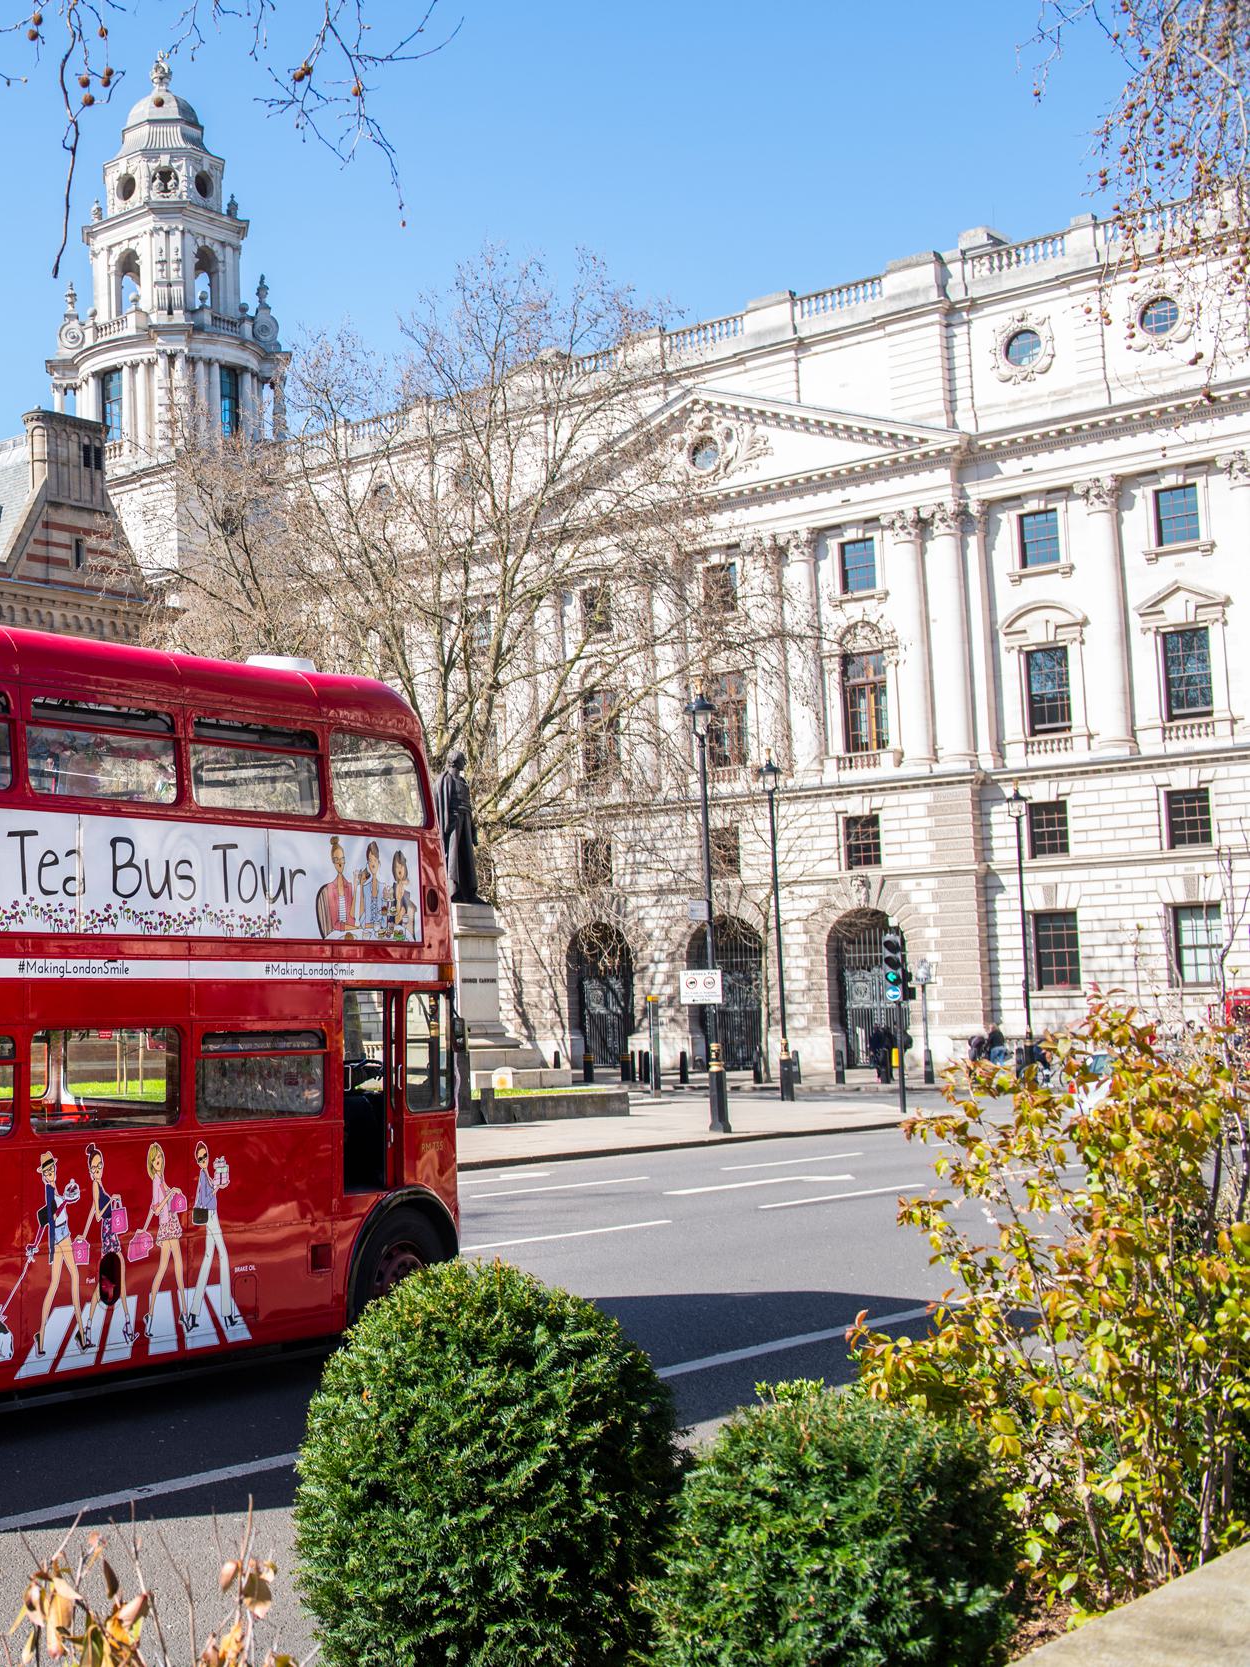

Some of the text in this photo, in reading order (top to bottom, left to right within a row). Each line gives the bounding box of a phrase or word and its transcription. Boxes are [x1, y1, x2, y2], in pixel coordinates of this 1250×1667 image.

[7, 829, 86, 897] Tea
[110, 836, 197, 901] Bus
[212, 843, 306, 904] Tour
[18, 960, 130, 979] #MakingLondonSmile
[265, 963, 355, 980] #MakingLondonSmile
